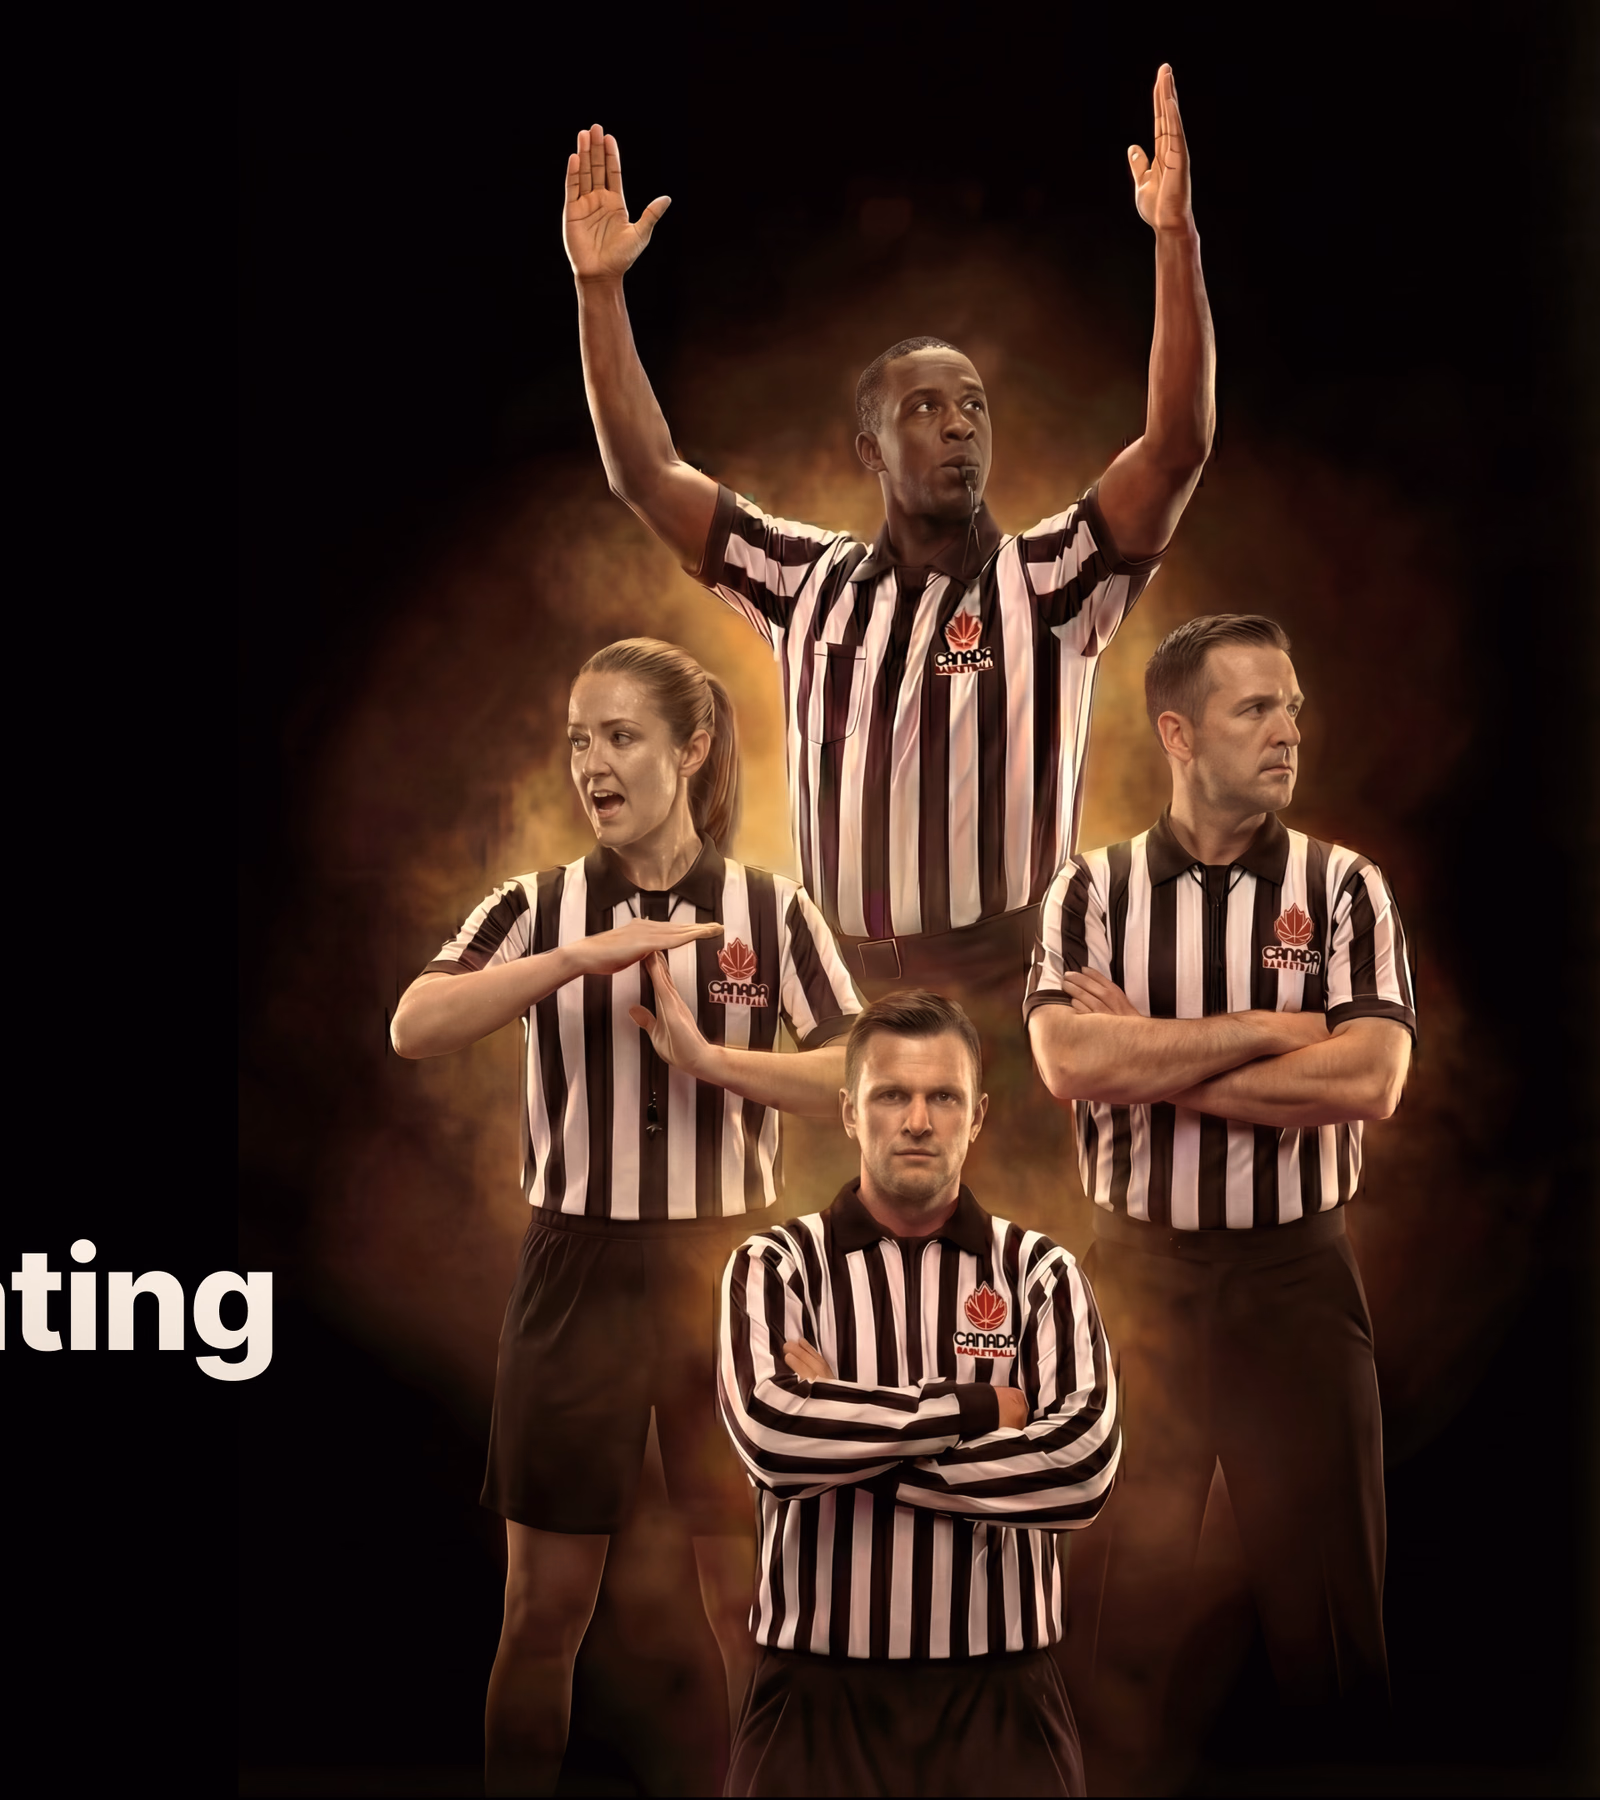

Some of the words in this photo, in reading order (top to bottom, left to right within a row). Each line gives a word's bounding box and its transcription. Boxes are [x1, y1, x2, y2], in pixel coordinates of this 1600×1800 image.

[935, 647, 992, 667] CANADA
[1263, 946, 1320, 964] CANADA
[709, 981, 768, 998] CANADA
[954, 1331, 1018, 1348] CANADA
